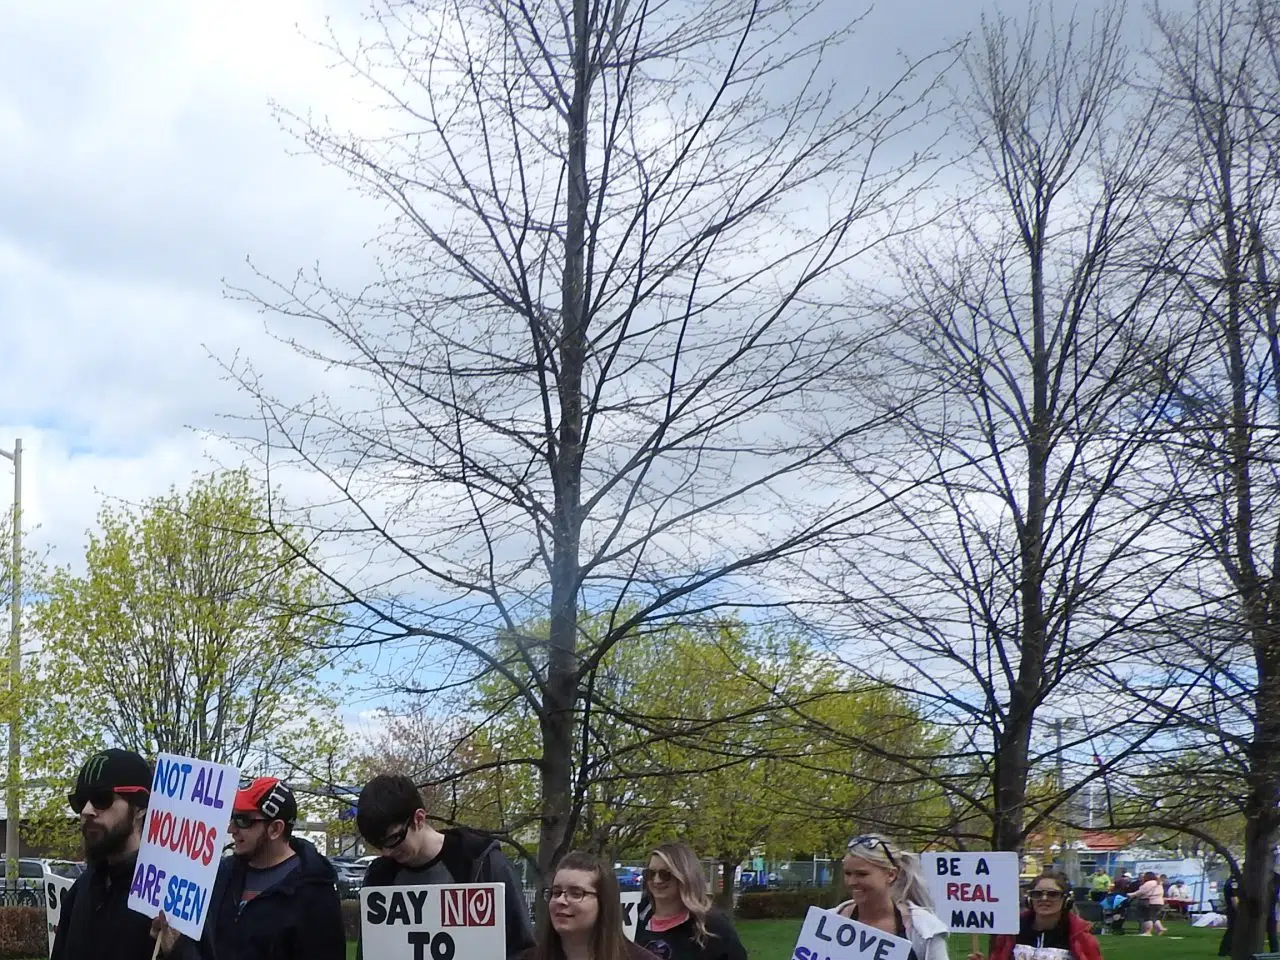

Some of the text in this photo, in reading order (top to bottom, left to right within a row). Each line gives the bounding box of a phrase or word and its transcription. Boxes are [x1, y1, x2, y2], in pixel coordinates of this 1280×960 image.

[153, 758, 224, 809] NOT ALL
[147, 809, 217, 866] WOUNDS
[936, 857, 990, 876] BE A
[130, 863, 207, 926] ARE SEEN
[367, 889, 492, 925] SAY NO
[947, 882, 999, 902] REAL
[951, 910, 994, 928] MAN
